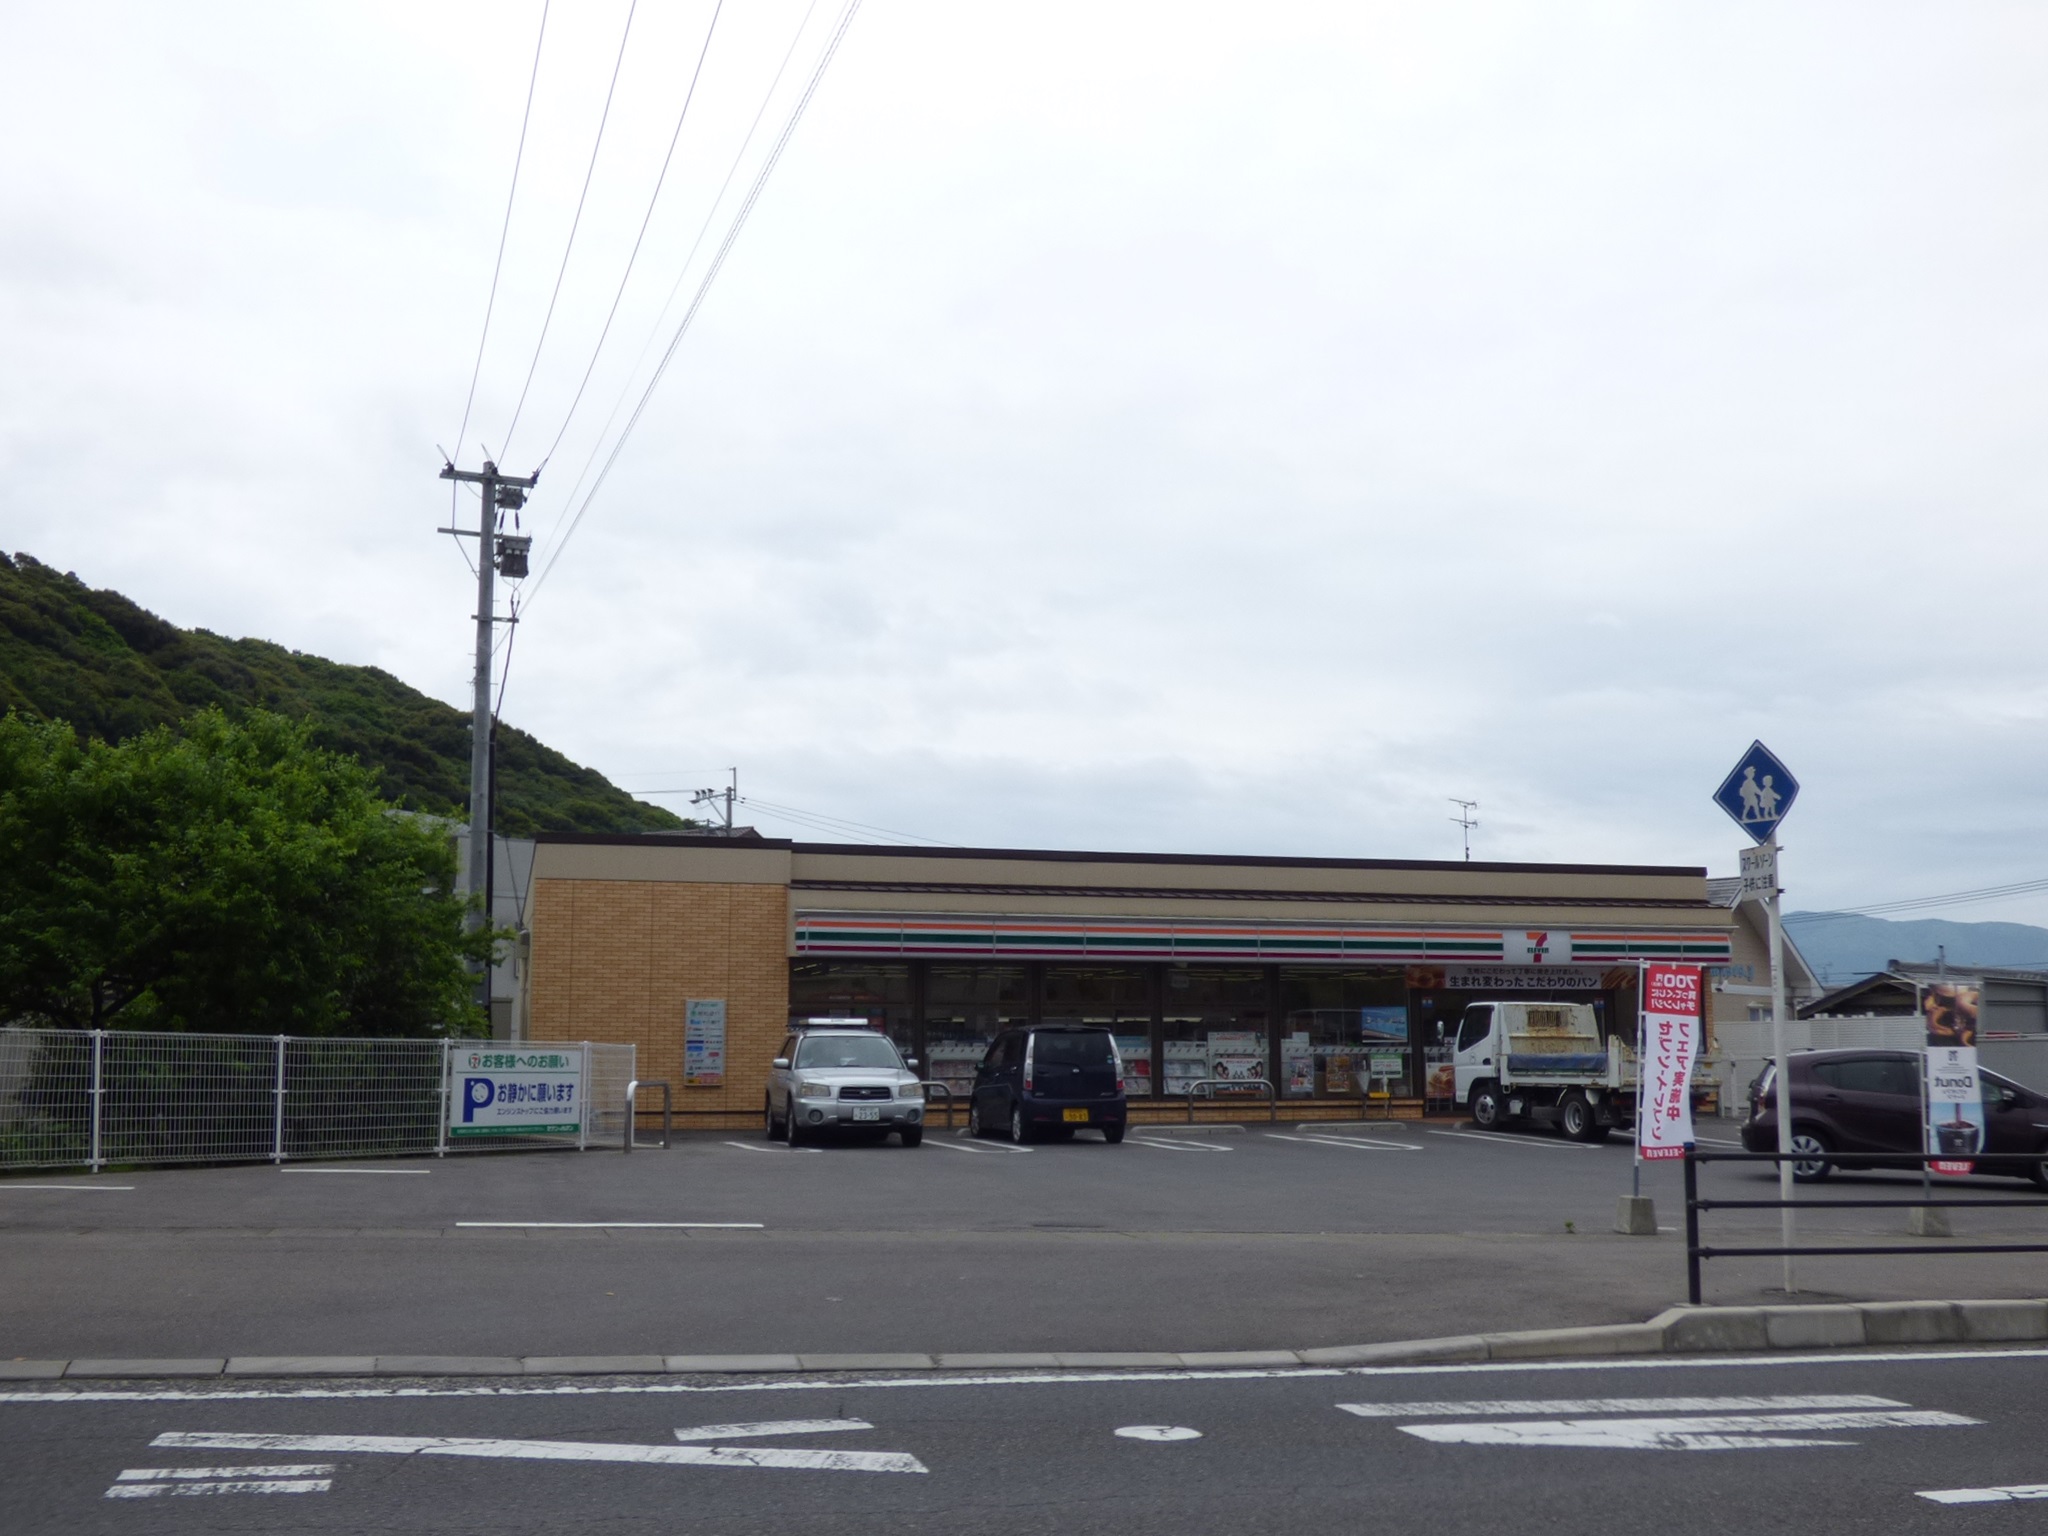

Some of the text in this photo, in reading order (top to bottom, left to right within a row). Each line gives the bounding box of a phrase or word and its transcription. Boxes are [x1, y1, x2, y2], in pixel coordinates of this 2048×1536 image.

[1742, 853, 1774, 872] スクールゾーン
[1743, 874, 1774, 892] 子供に注意
[1450, 976, 1598, 988] 生まれ変わった こだわりのパン
[482, 1053, 570, 1069] お客様へのお願い
[497, 1082, 575, 1104] お静かに願います
